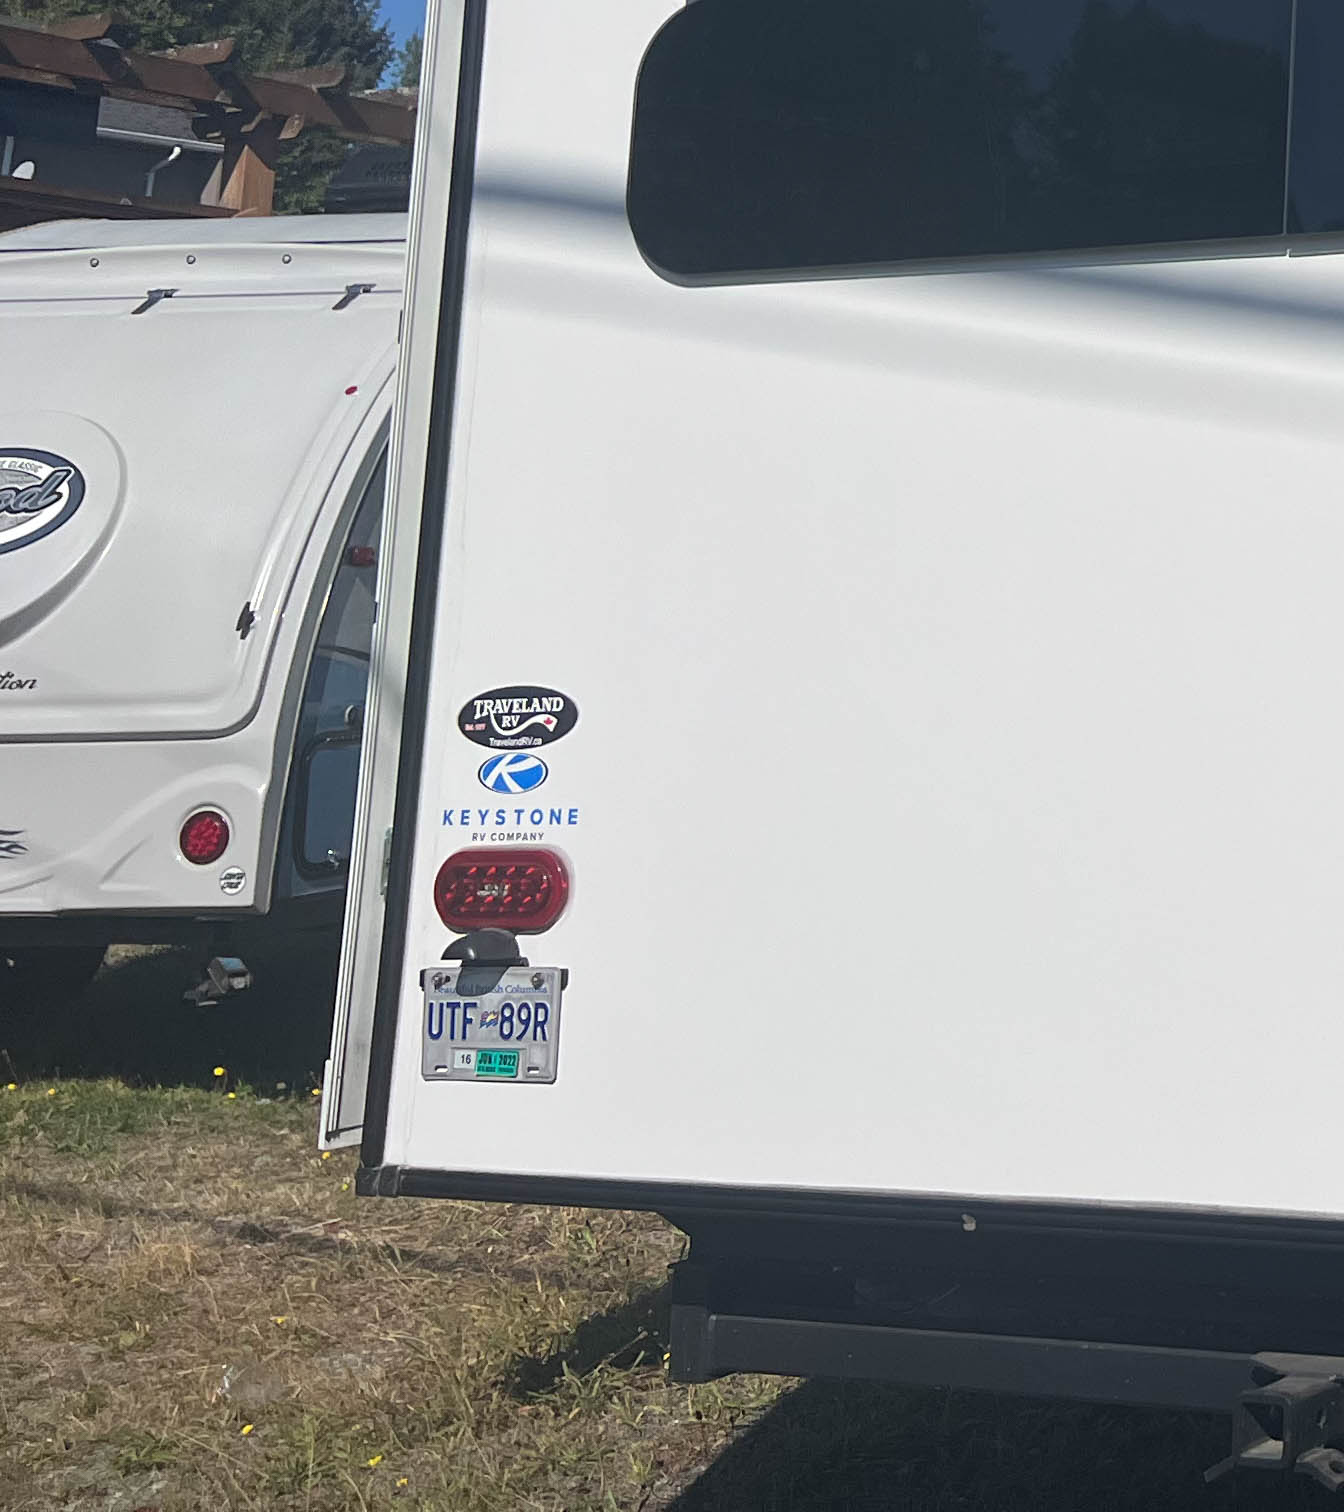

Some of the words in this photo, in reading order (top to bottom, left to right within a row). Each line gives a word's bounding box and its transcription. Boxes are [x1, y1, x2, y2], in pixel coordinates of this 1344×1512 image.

[473, 696, 565, 720] TRAVELAND
[501, 714, 521, 728] RV
[442, 807, 580, 826] KEYSTONE
[471, 832, 487, 841] RV
[490, 832, 545, 841] COMPANY
[427, 1001, 478, 1041] UTF
[499, 1001, 550, 1041] 89R
[460, 1054, 472, 1065] 16
[498, 1054, 517, 1066] 2022
